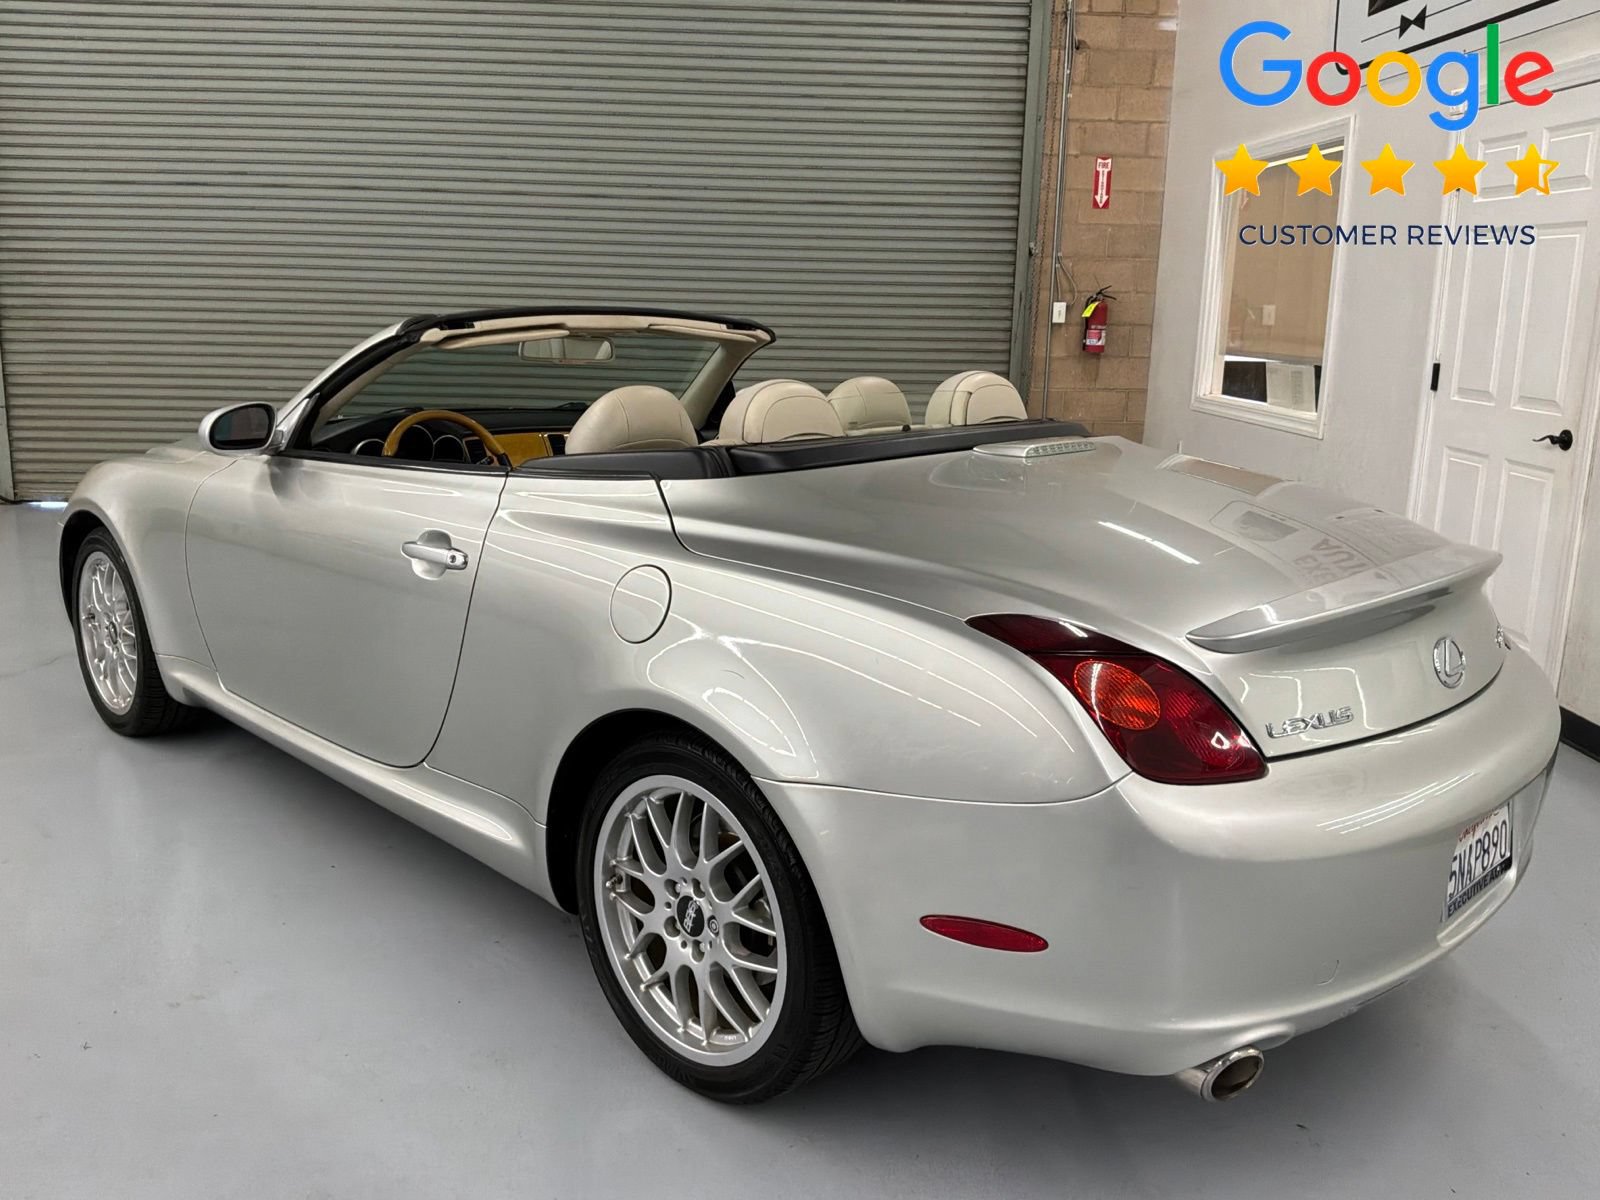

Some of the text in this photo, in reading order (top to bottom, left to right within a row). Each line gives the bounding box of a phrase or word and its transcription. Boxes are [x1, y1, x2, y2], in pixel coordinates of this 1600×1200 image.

[1098, 161, 1110, 170] FIRE
[1265, 705, 1354, 739] LEXUS
[1448, 819, 1508, 896] 5NAP890
